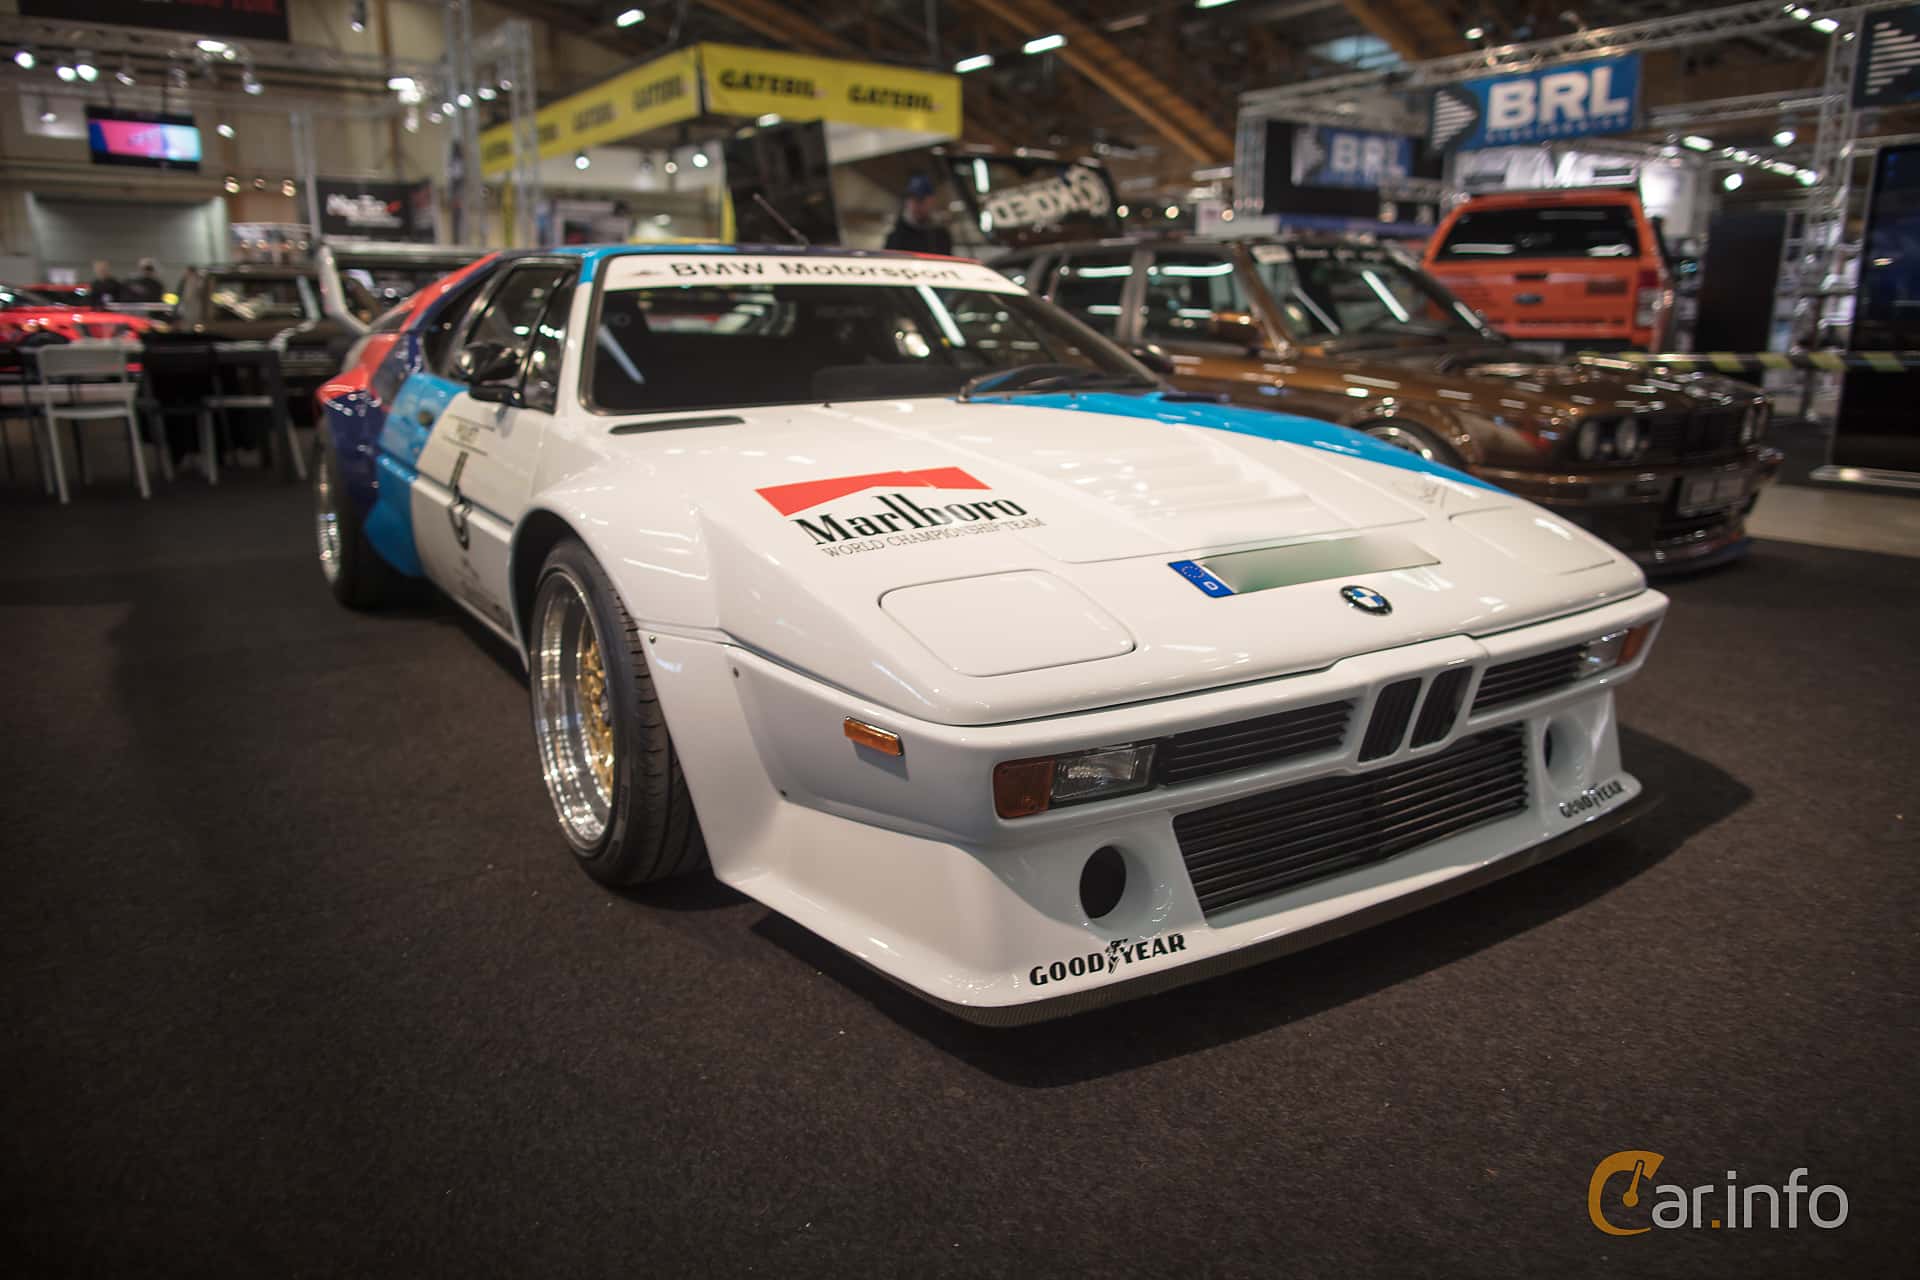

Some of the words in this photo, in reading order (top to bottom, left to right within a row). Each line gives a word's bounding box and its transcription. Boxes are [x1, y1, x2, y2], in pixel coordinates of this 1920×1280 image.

[1486, 66, 1630, 130] BRL
[669, 262, 764, 278] BMW
[779, 262, 962, 281] Motorsport
[791, 493, 1028, 545] Marlboro
[822, 538, 886, 558] WORLD
[886, 521, 1003, 547] CHAMPIONSHIP
[1000, 516, 1046, 532] TEAM
[1029, 933, 1187, 986] GOODYEAR
